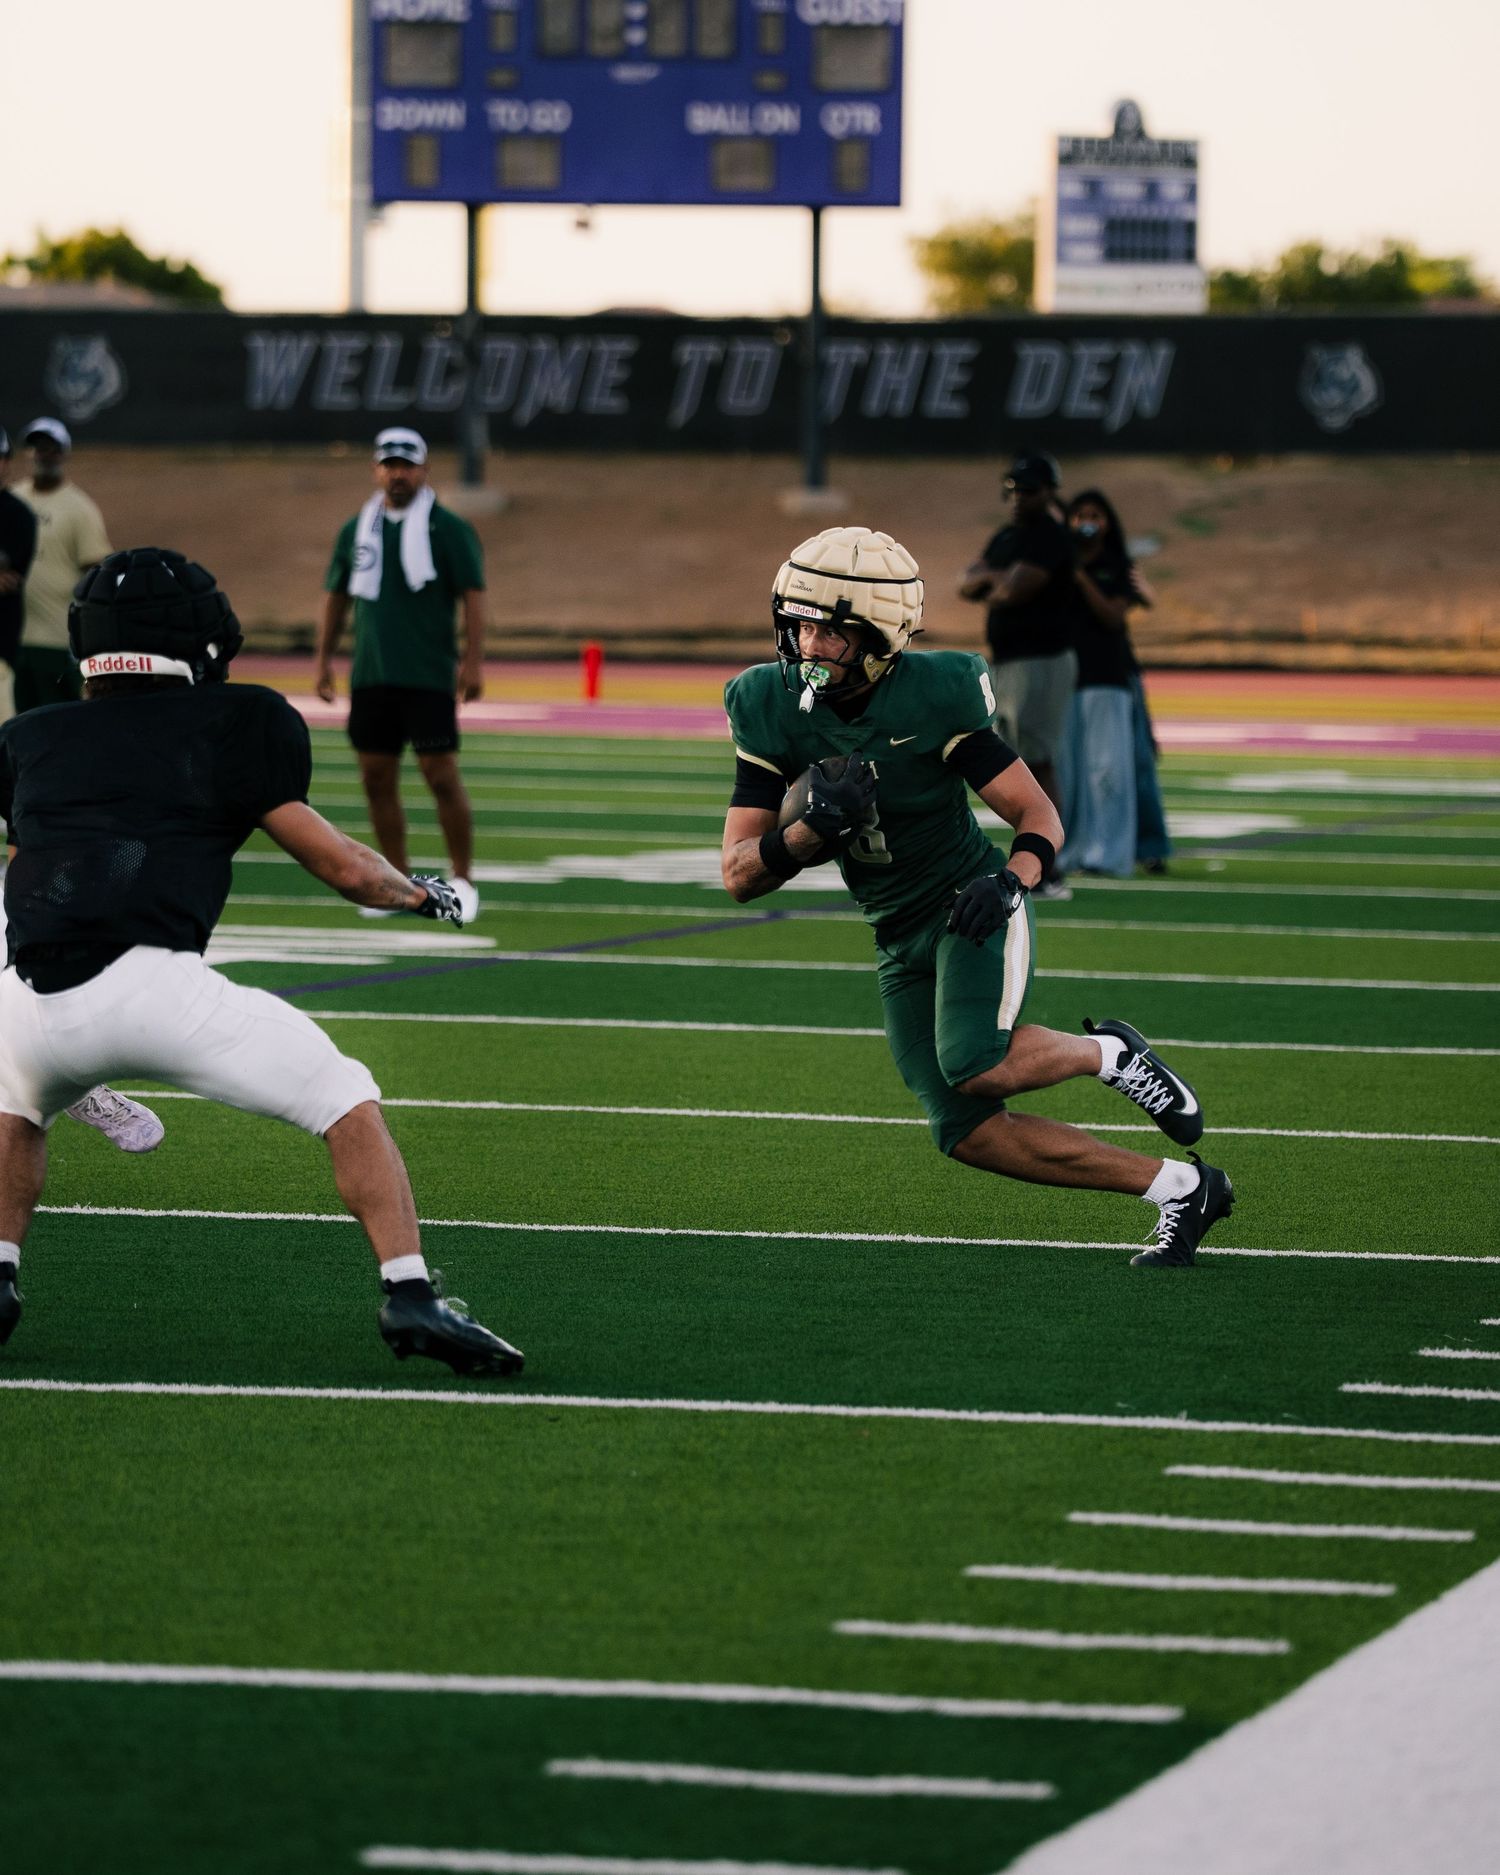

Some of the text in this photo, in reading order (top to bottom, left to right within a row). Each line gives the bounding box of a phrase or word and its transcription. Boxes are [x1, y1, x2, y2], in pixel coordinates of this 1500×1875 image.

[376, 100, 466, 131] DOWN
[485, 100, 572, 133] TO GO
[686, 102, 801, 135] BALL ON
[820, 103, 881, 139] QTR
[244, 333, 1175, 433] WELCOME TO THE DEN
[787, 604, 818, 616] Riddell
[87, 656, 152, 674] Riddell
[979, 672, 997, 717] 8
